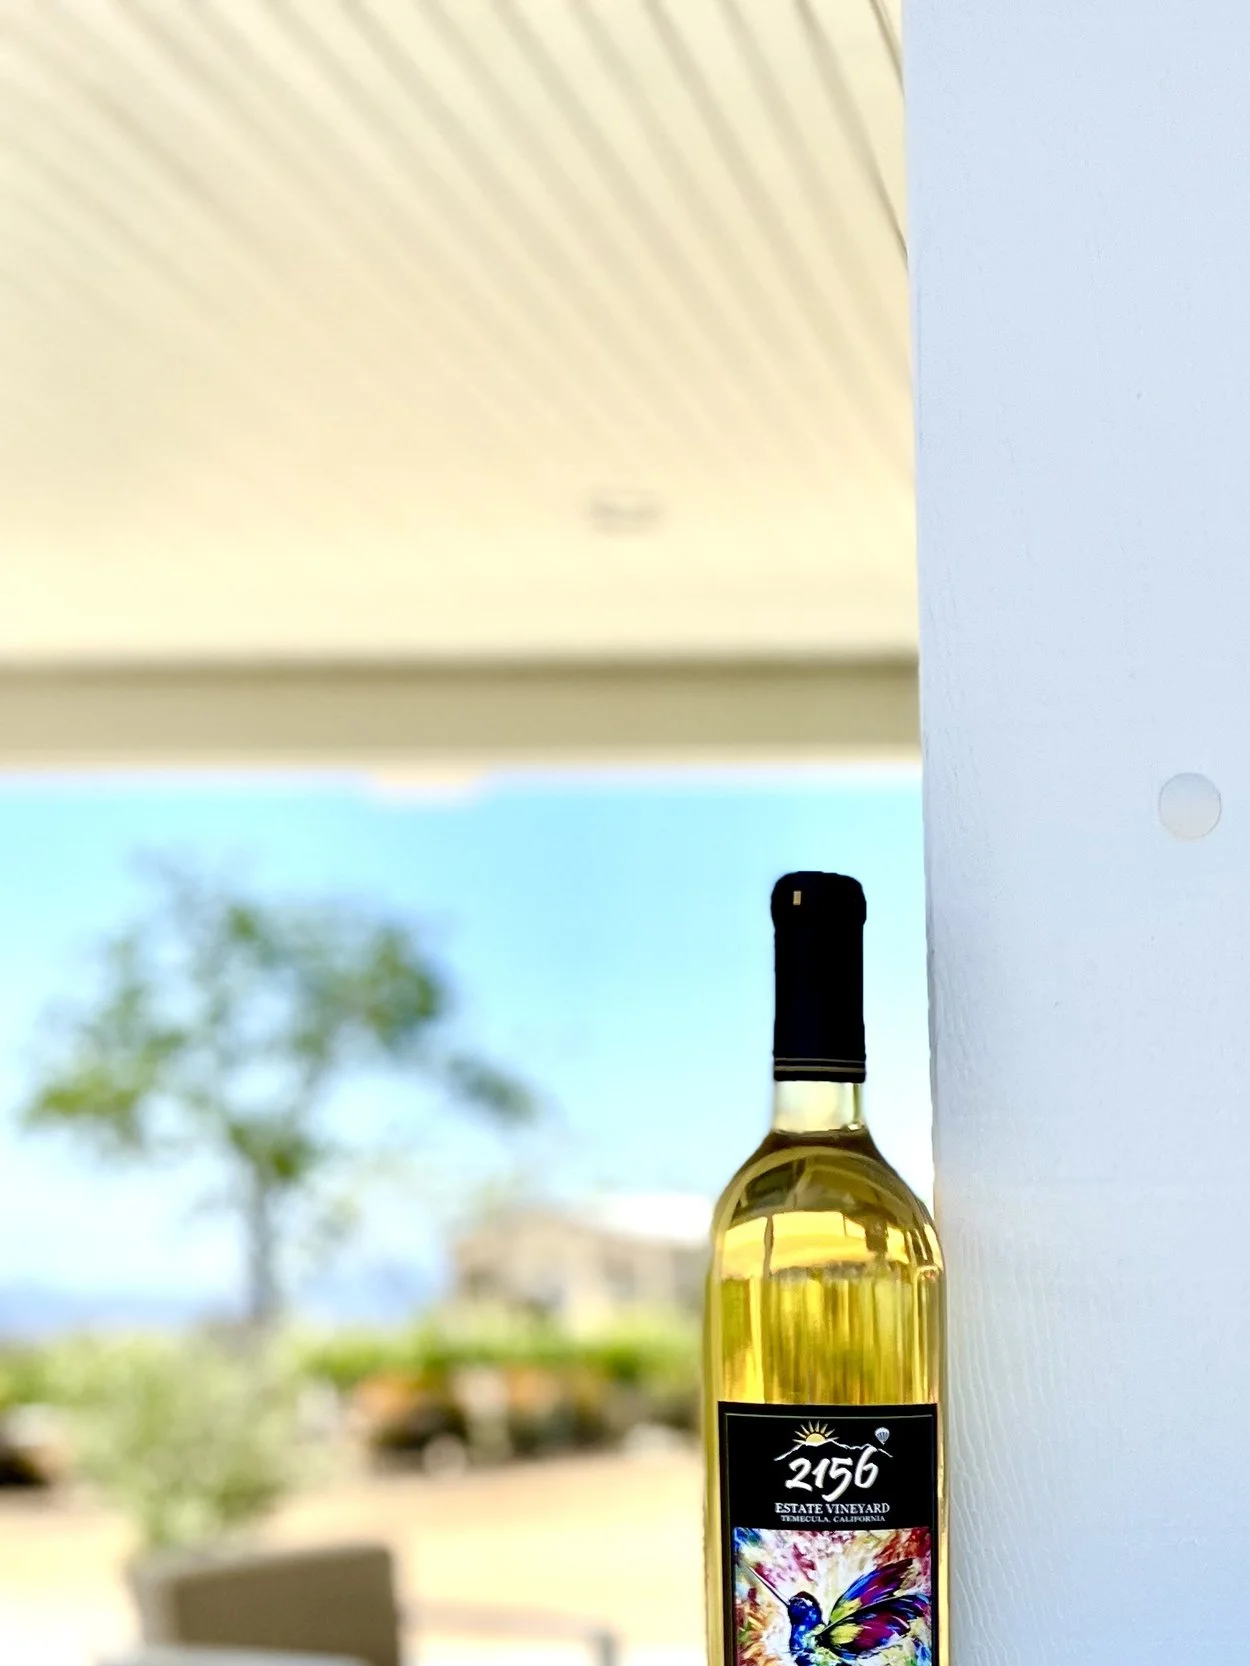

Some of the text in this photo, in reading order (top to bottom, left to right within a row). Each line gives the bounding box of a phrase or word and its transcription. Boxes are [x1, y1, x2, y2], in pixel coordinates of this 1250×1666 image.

[785, 1446, 879, 1502] 2156
[775, 1502, 890, 1514] ESTATE VINEYARD
